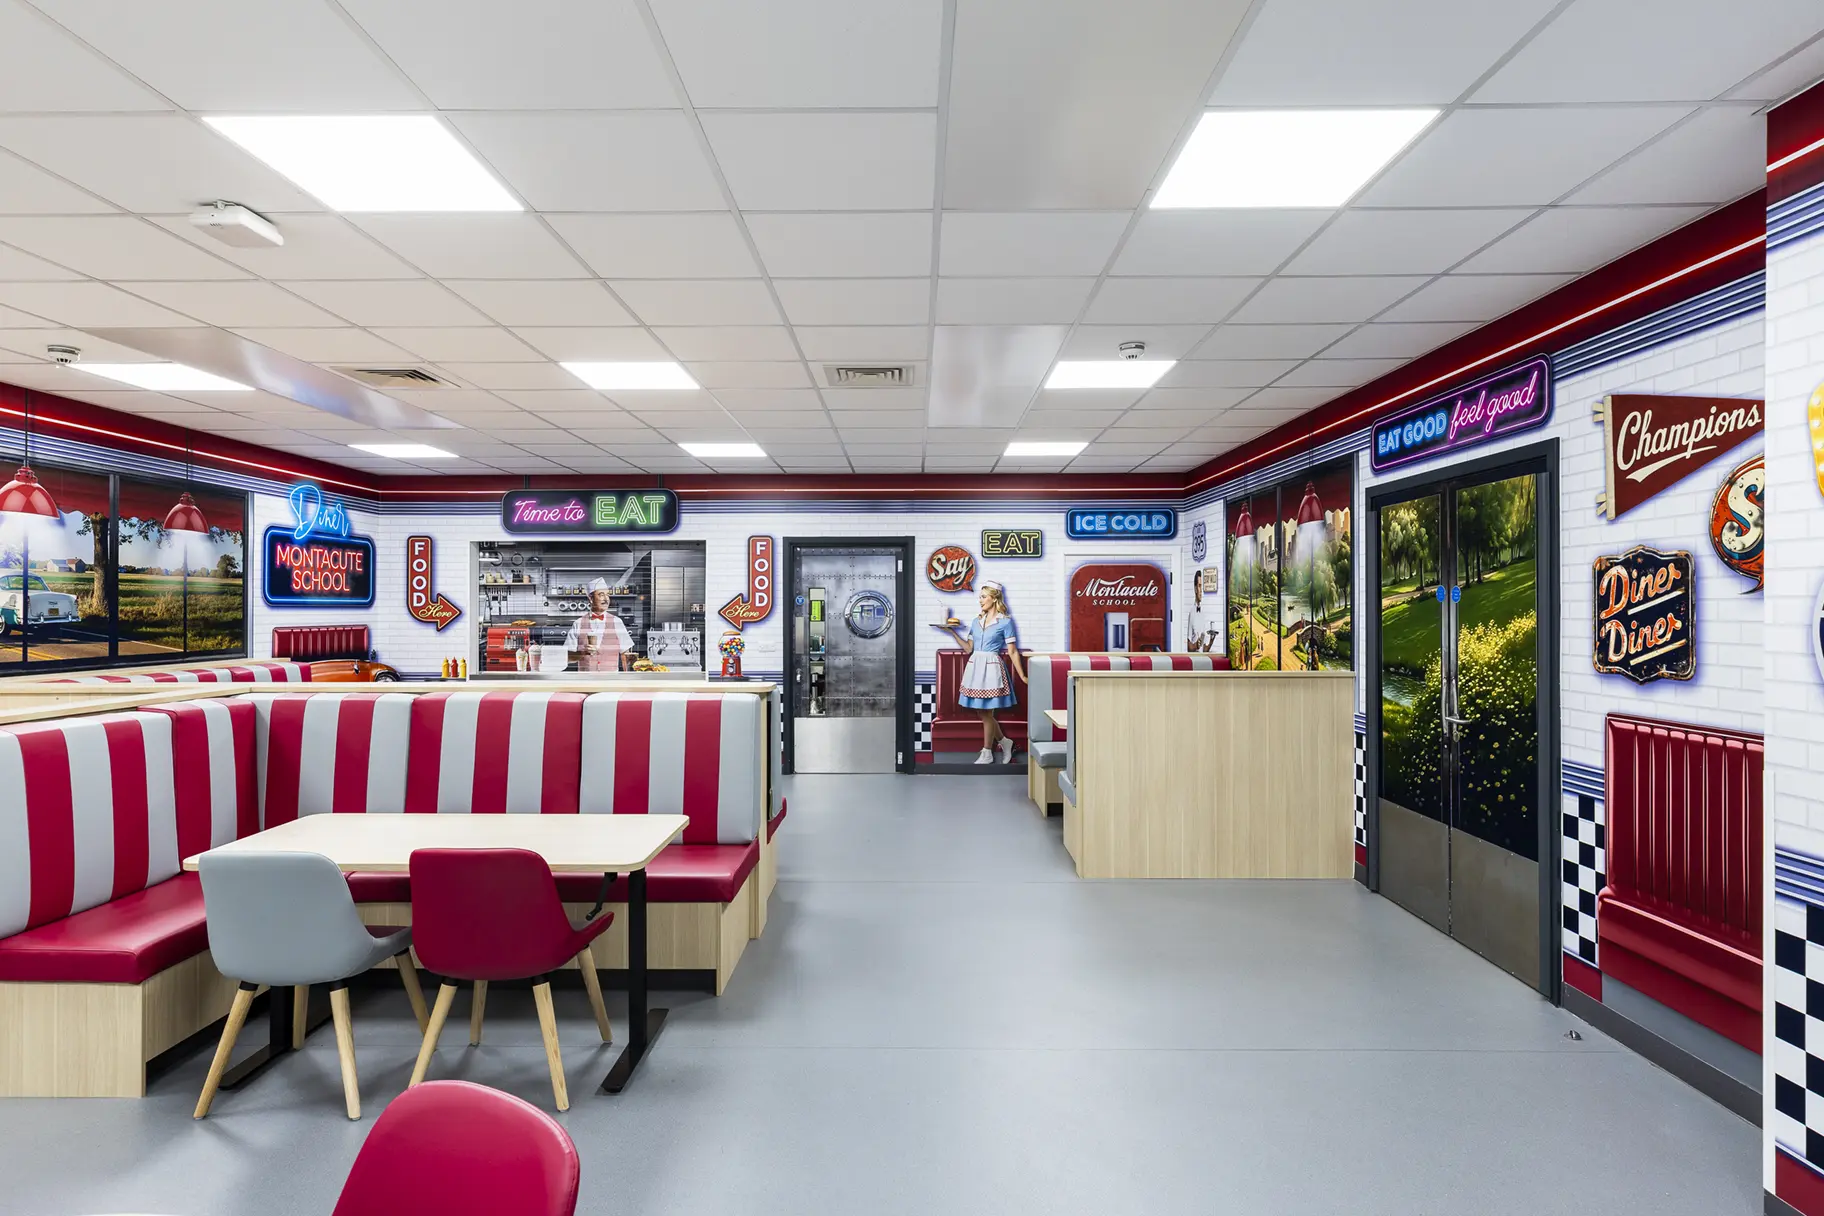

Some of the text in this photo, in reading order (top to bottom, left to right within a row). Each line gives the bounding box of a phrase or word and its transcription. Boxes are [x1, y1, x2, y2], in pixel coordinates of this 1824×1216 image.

[1378, 370, 1538, 454] EAT GOOD feel good
[1616, 403, 1762, 471] Champions
[289, 484, 349, 540] Diner
[514, 495, 666, 525] Time to EAT
[1075, 515, 1167, 531] ICE COLD
[276, 544, 363, 571] MONTACUTE
[984, 532, 1039, 554] EAT
[292, 570, 350, 592] SCHOOL
[412, 541, 428, 607] FOOD
[754, 541, 770, 608] FOOD
[930, 554, 973, 582] Say
[1076, 575, 1159, 597] Montacute
[1600, 561, 1682, 620] Diner
[418, 603, 453, 619] Here
[725, 603, 760, 618] Here
[1601, 613, 1682, 662] Diner
